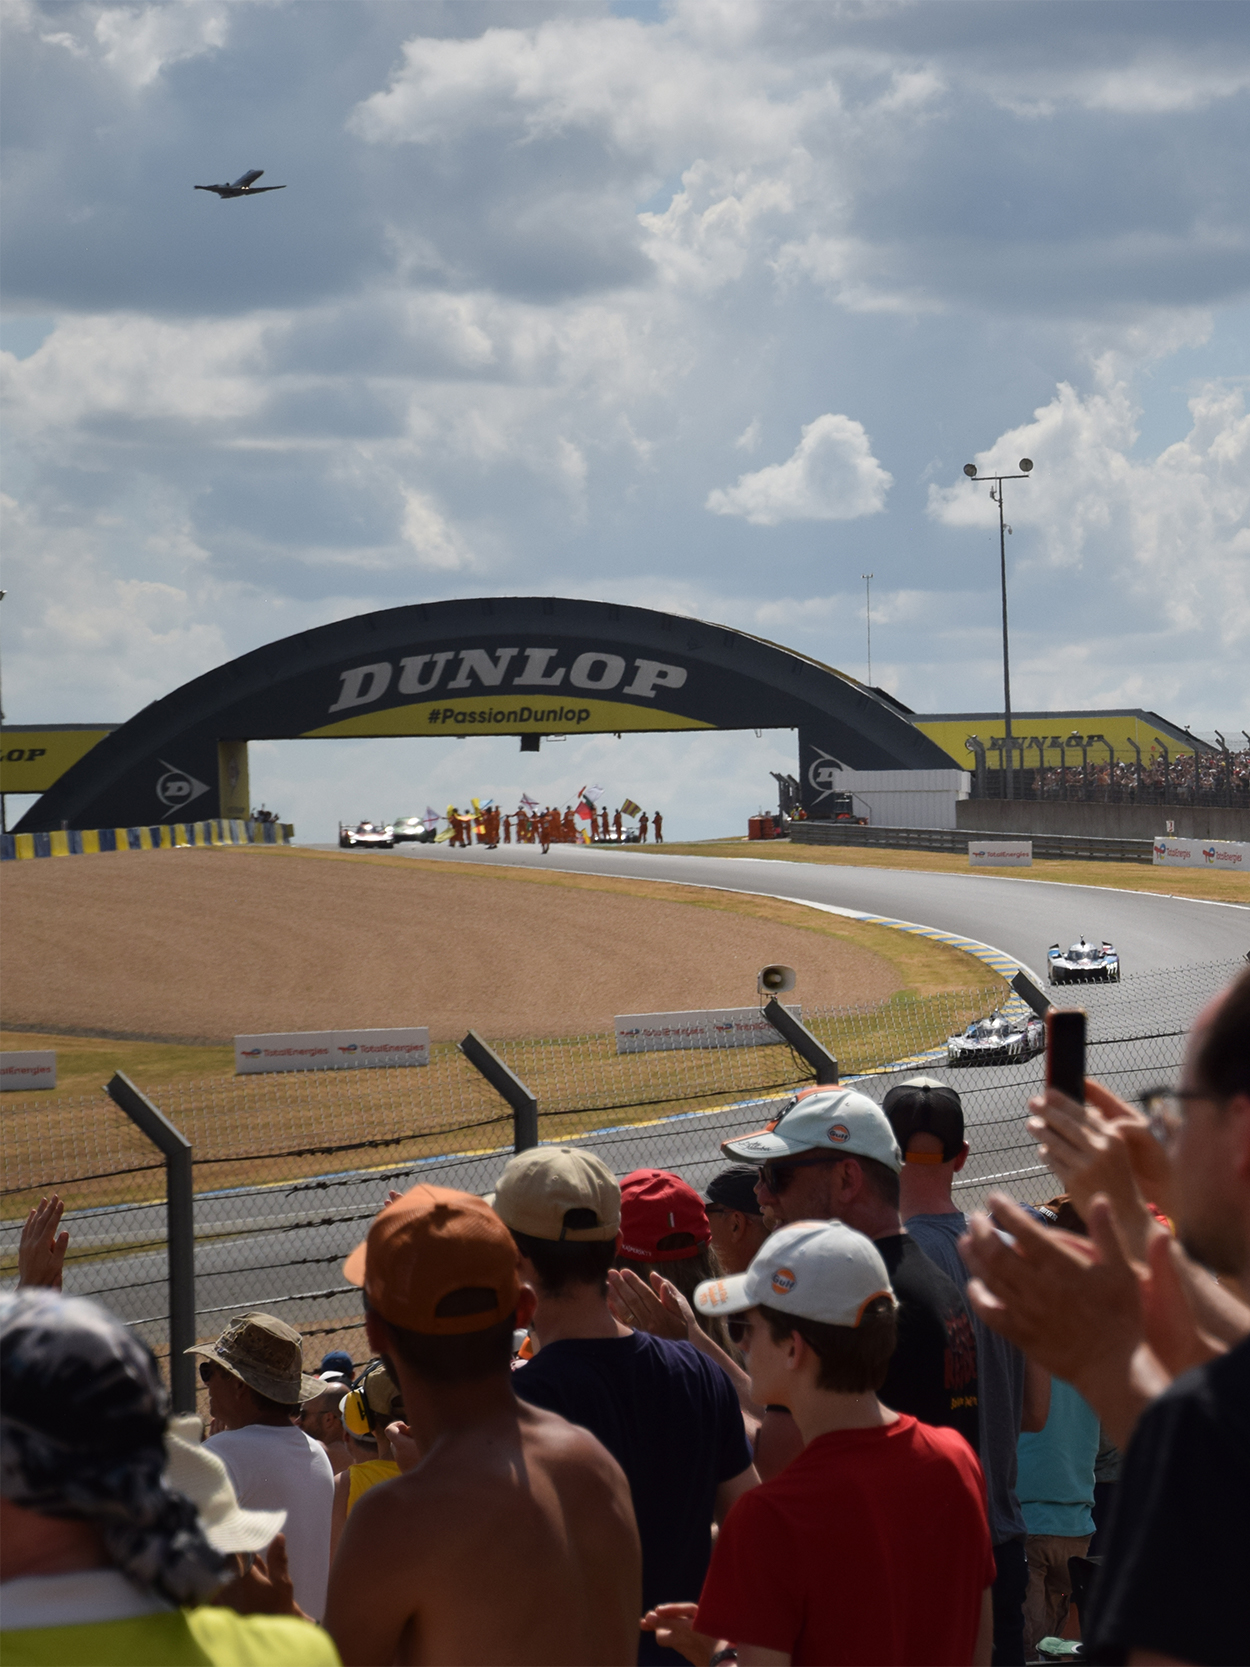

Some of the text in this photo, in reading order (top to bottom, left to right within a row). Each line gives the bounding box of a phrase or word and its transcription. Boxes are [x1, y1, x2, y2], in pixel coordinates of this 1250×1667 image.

[328, 647, 688, 713] DUNLOP
[427, 707, 591, 726] #PassionDunlop
[264, 1043, 426, 1058] TotalEnergies TotalEnergies
[772, 1273, 796, 1290] Gulf
